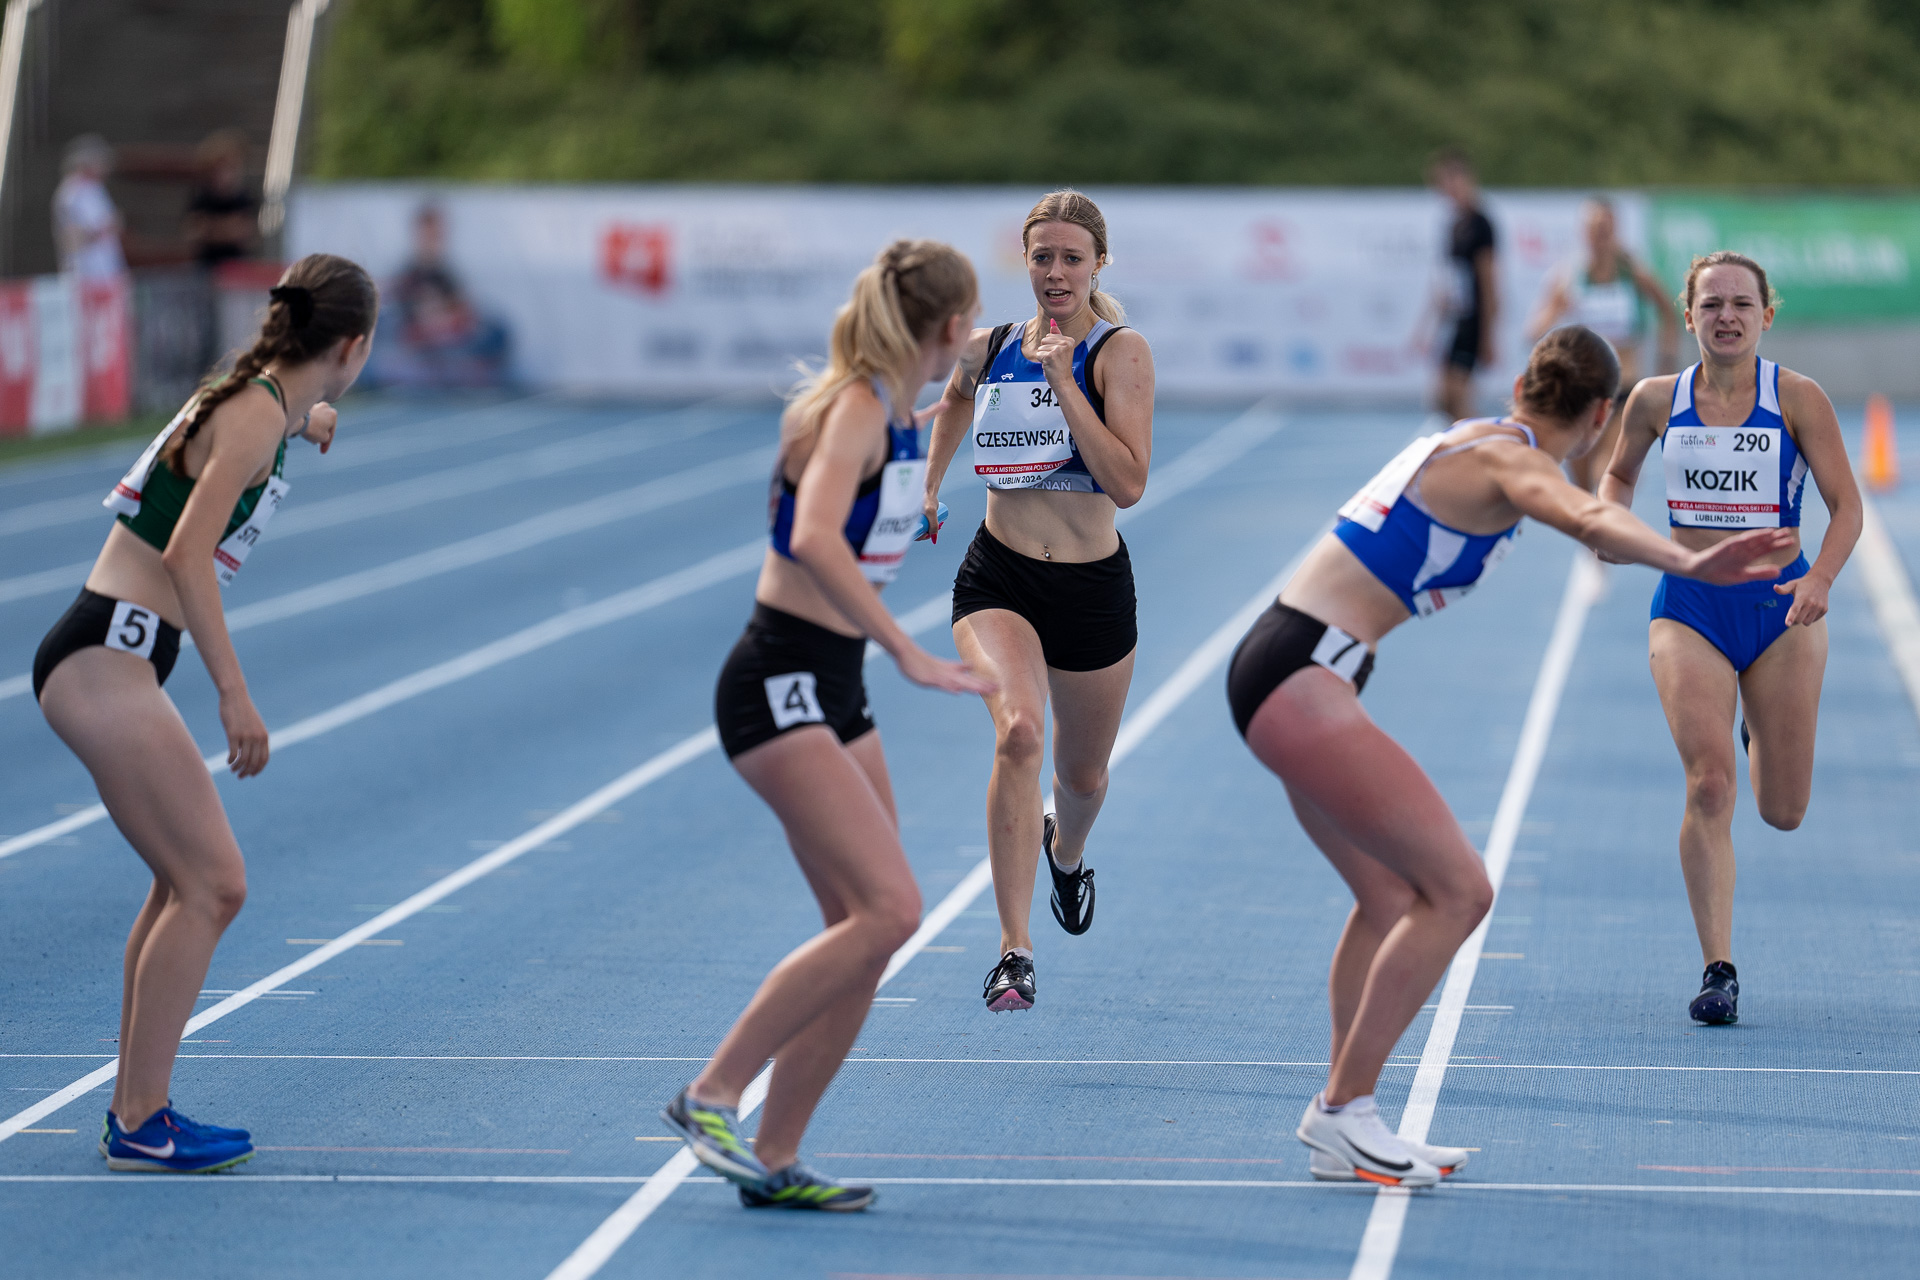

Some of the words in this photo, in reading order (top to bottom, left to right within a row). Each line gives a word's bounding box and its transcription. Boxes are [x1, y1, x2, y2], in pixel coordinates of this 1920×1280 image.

[976, 429, 1065, 448] CZESZEWSKA
[1733, 433, 1770, 452] 290
[999, 465, 1033, 473] MISTRZOSTWA
[998, 476, 1021, 485] LUBLIN
[1021, 474, 1042, 484] 2024
[1684, 469, 1758, 492] KOZIK
[1694, 503, 1738, 512] MISTRZOSTWA
[1738, 504, 1760, 513] POLSKI
[1695, 514, 1723, 522] LUBLIN
[1724, 515, 1746, 523] 2024
[119, 608, 149, 648] 5
[1330, 639, 1360, 666] 7
[783, 680, 809, 715] 4
